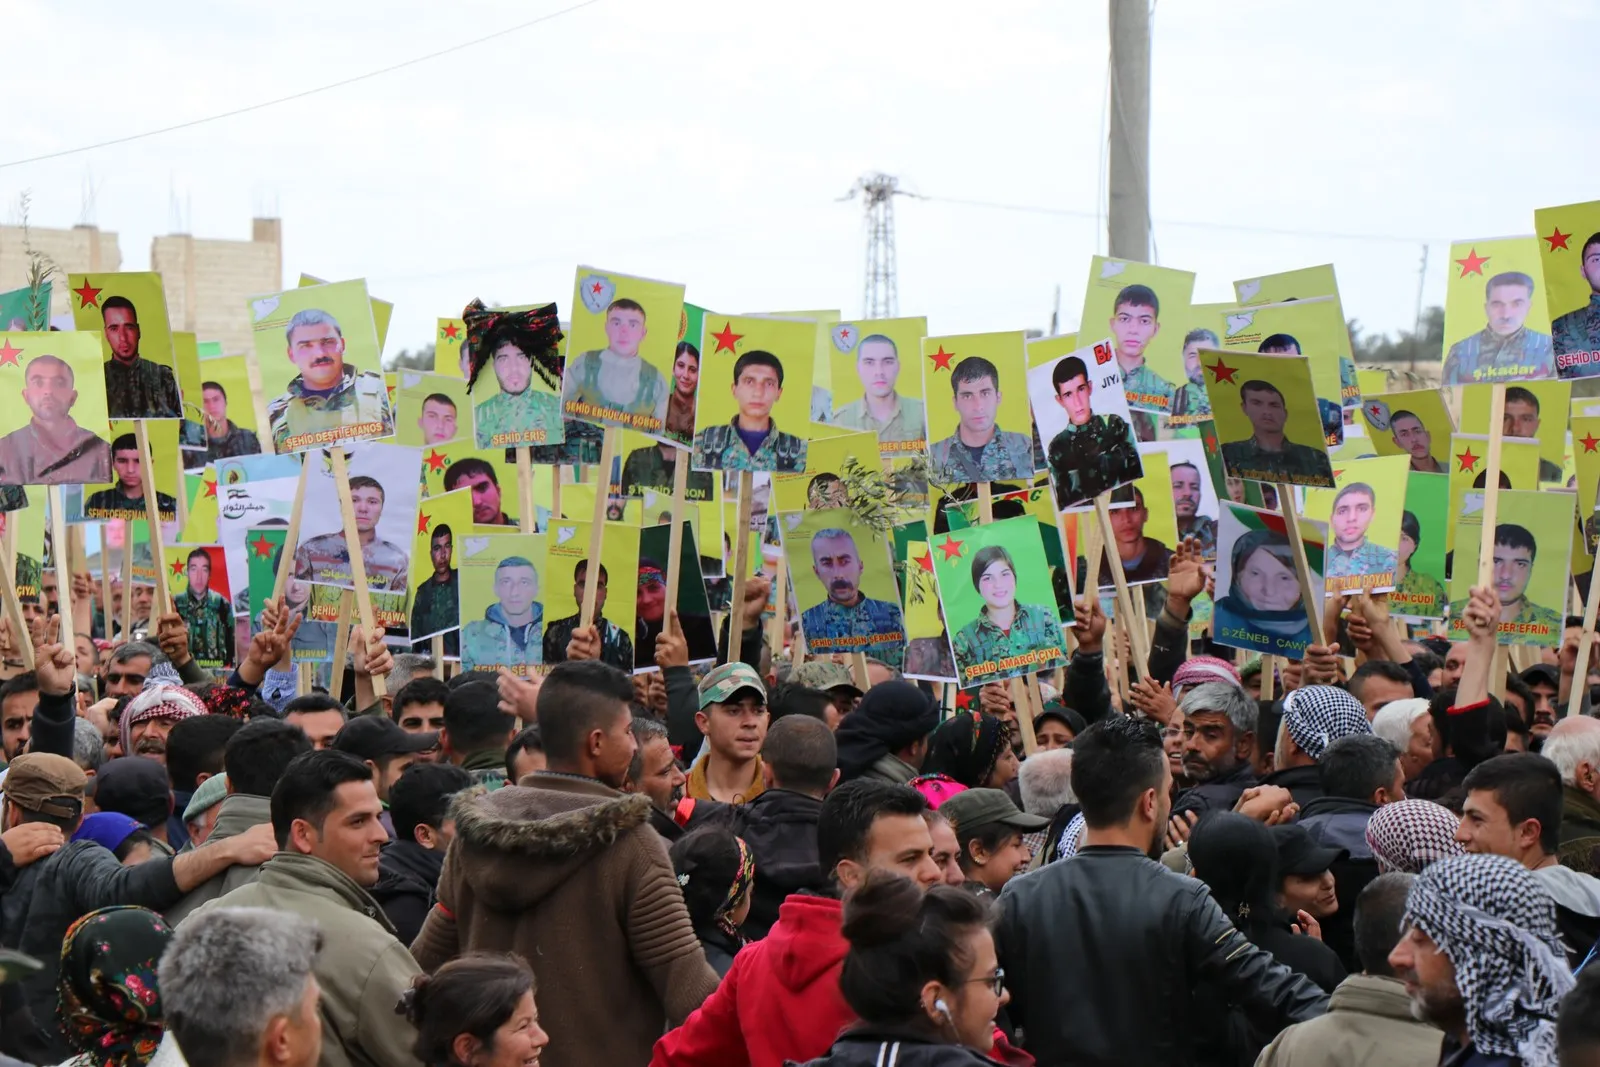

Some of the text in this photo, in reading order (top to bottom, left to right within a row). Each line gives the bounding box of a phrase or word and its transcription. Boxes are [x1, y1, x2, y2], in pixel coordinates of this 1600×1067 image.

[1558, 350, 1590, 369] ŞEHİD
[1102, 374, 1119, 389] JIY
[286, 432, 313, 449] ŞEHİD
[492, 430, 521, 447] ŞEHİD
[1326, 574, 1361, 591] MZLUM
[965, 647, 1062, 680] ŞEHİD AMARGİ ÇIYA
